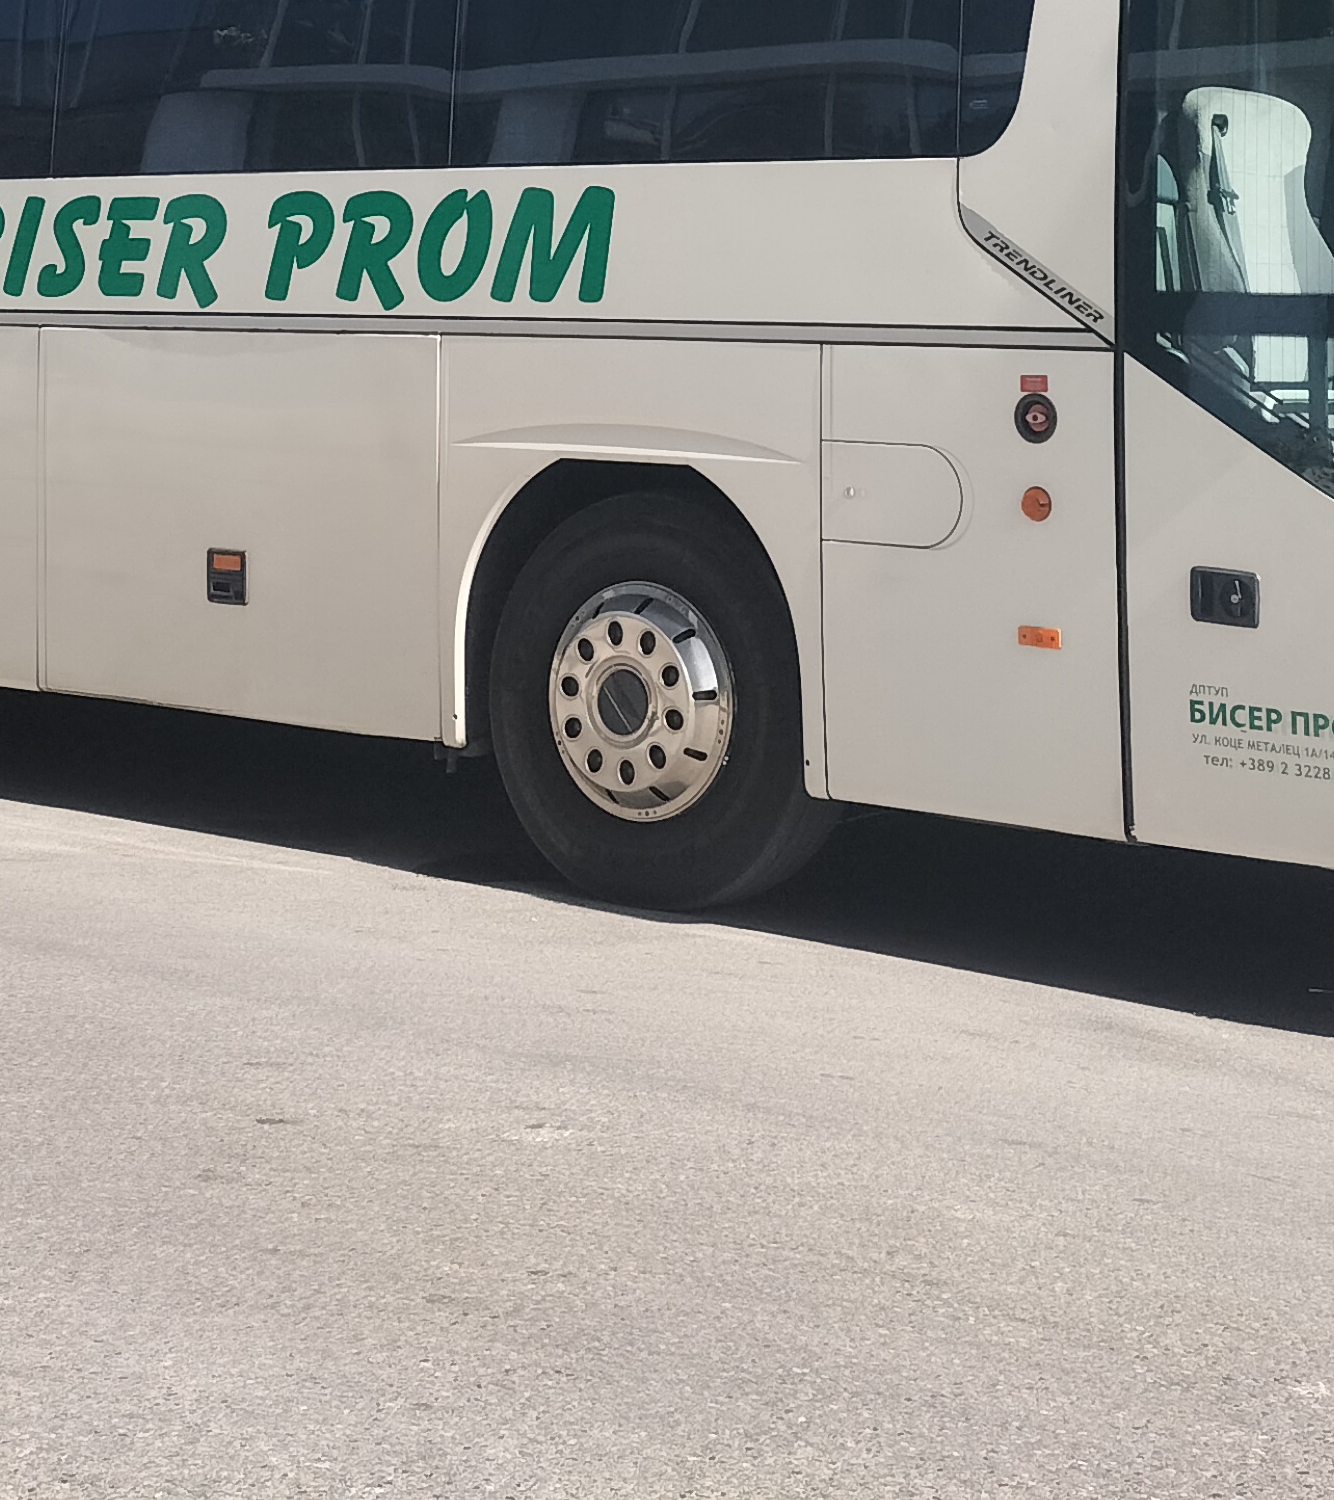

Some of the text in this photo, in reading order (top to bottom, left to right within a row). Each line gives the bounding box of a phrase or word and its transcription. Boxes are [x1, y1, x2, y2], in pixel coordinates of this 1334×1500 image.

[264, 185, 616, 311] PROM
[983, 230, 1105, 324] TRENDLINER
[1190, 683, 1229, 698] ДПТУП
[1189, 699, 1283, 732] БИСЕР
[1214, 736, 1244, 751] КОЦЕ
[1247, 740, 1301, 758] МЕТАЛЕЦ
[1204, 754, 1233, 769] тел:
[1239, 757, 1275, 773] +389
[1280, 761, 1289, 775] 2
[1294, 763, 1331, 780] 3228
